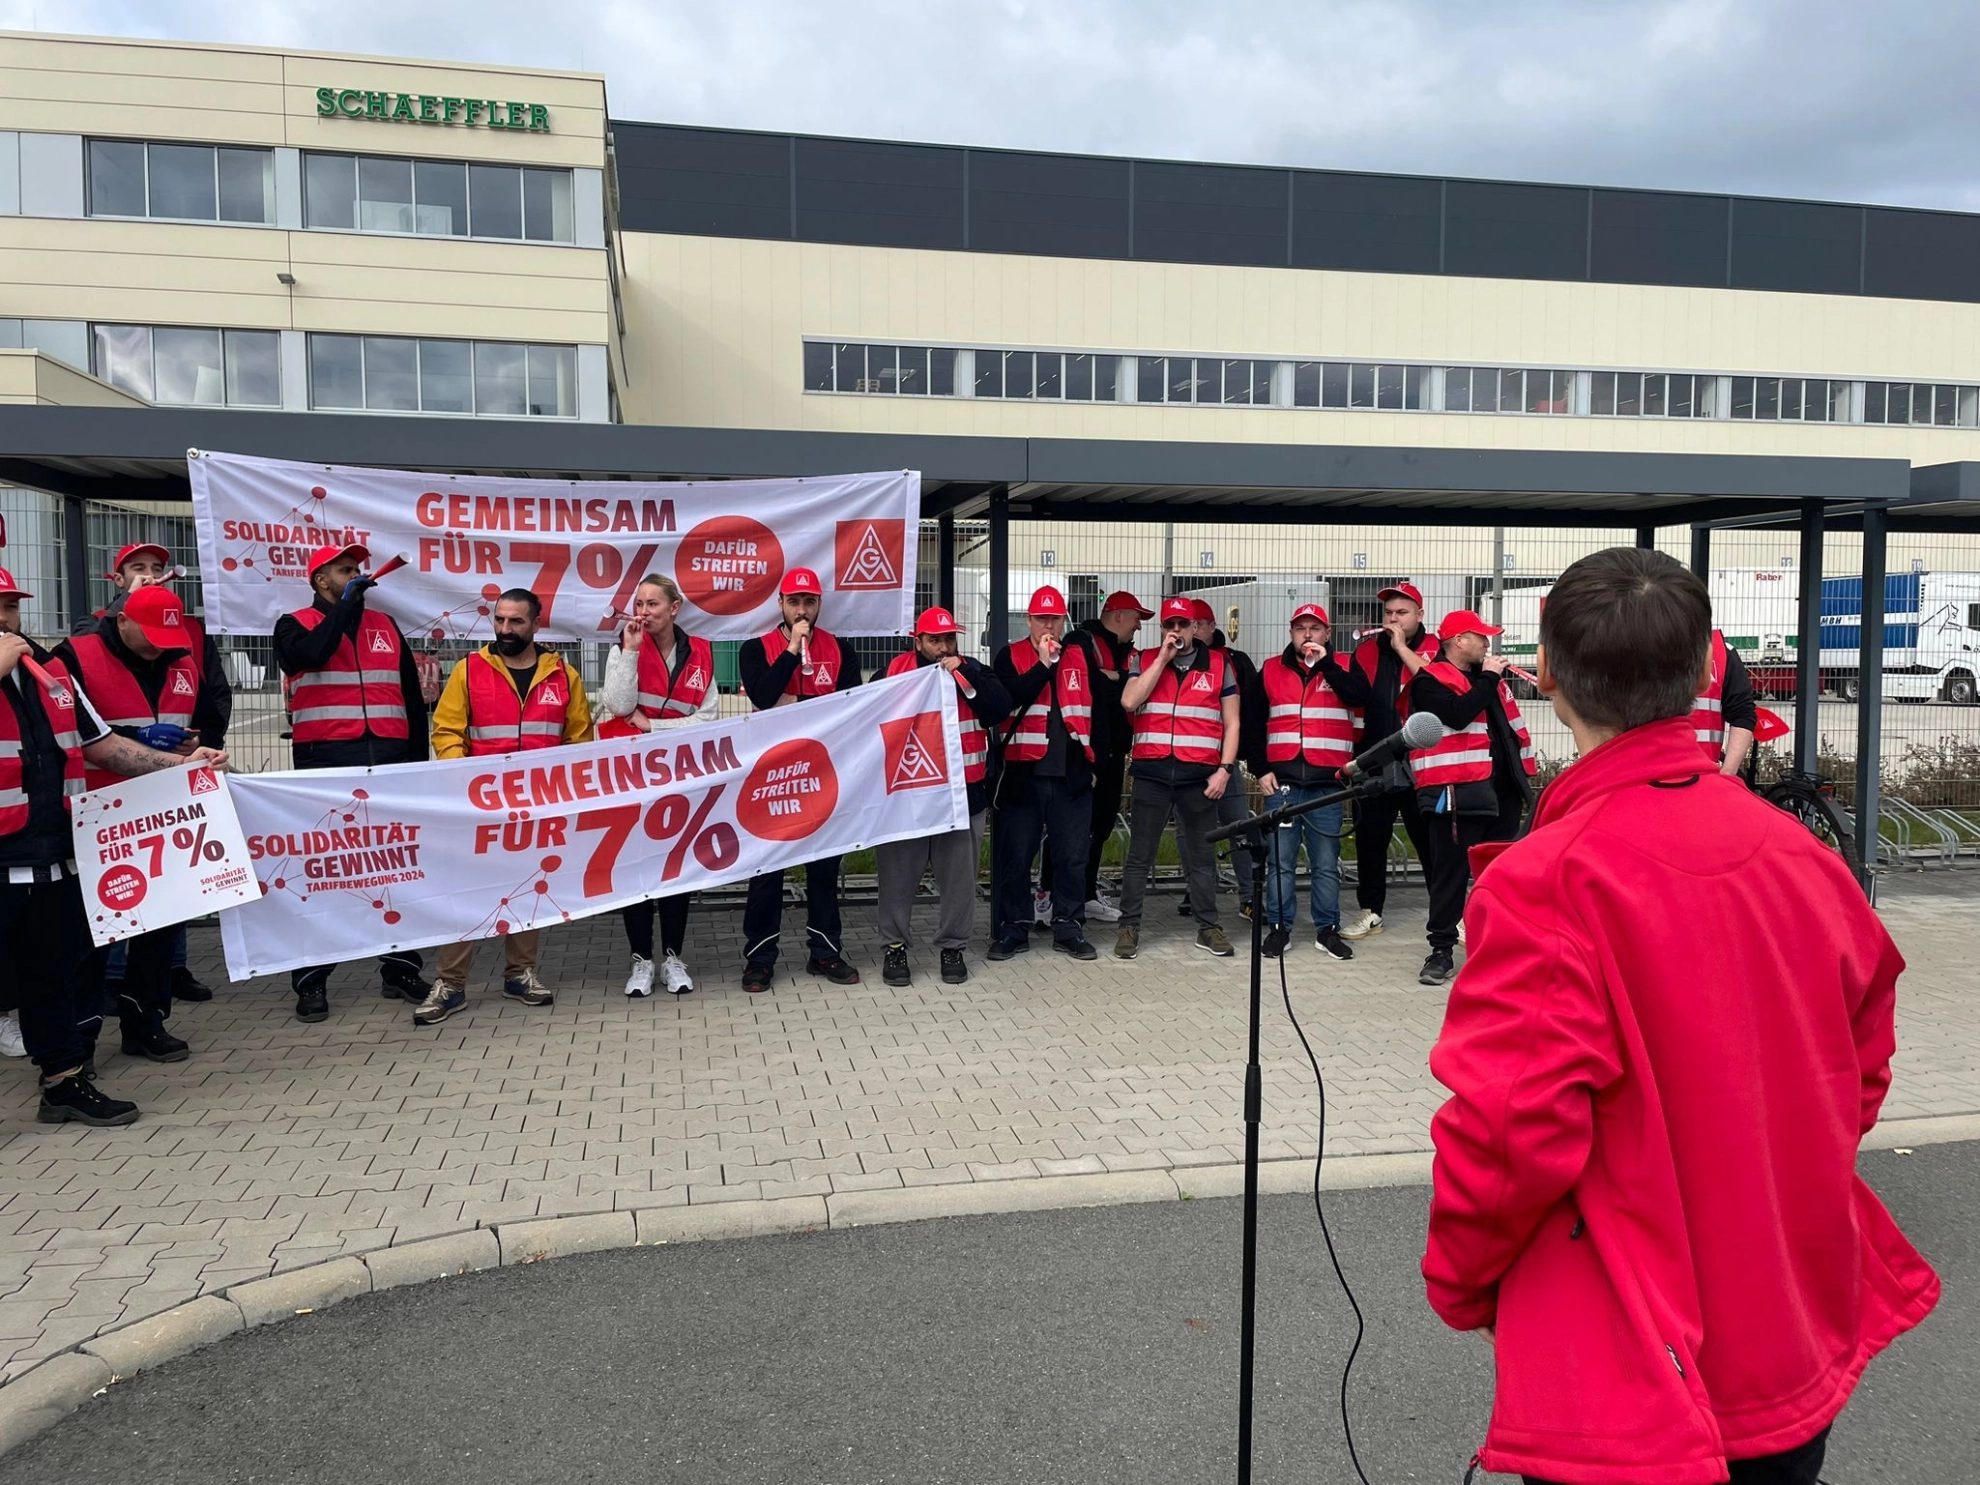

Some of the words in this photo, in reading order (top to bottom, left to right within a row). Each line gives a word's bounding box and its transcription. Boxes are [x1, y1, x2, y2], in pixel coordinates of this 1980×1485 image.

[316, 87, 550, 132] SCHAEFFLER
[416, 492, 677, 533] GEMEINSAM
[223, 520, 370, 550] SOLIDARITÄT
[268, 546, 370, 570] GEWT
[418, 531, 503, 574] FÜR
[704, 538, 757, 557] DAFÜR
[1042, 551, 1054, 565] 13
[691, 556, 768, 575] STREITEN
[1201, 553, 1213, 567] 14
[1354, 554, 1366, 568] 15
[712, 576, 744, 591] WIR
[1821, 616, 1842, 625] MBH
[468, 735, 742, 811] GEMEINSAM
[766, 761, 811, 783] DAFÜR
[751, 777, 821, 801] STREITEN
[768, 799, 802, 816] WIR
[96, 802, 206, 845] GEMEINSAM
[98, 842, 134, 865] FÜR
[138, 822, 225, 878] 7%
[247, 822, 421, 860] SOLIDARITÄT
[474, 810, 567, 855] FÜR
[575, 783, 740, 898] 7%
[304, 844, 420, 879] GEWINNT
[107, 873, 133, 888] DAFÜR
[200, 867, 246, 886] SOLIDARITÄT
[215, 873, 248, 888] GEWINNT
[306, 874, 398, 893] TARIFBEWEGUNG
[400, 870, 425, 881] 2024
[105, 880, 140, 898] STREITEN
[116, 890, 135, 901] WIR!
